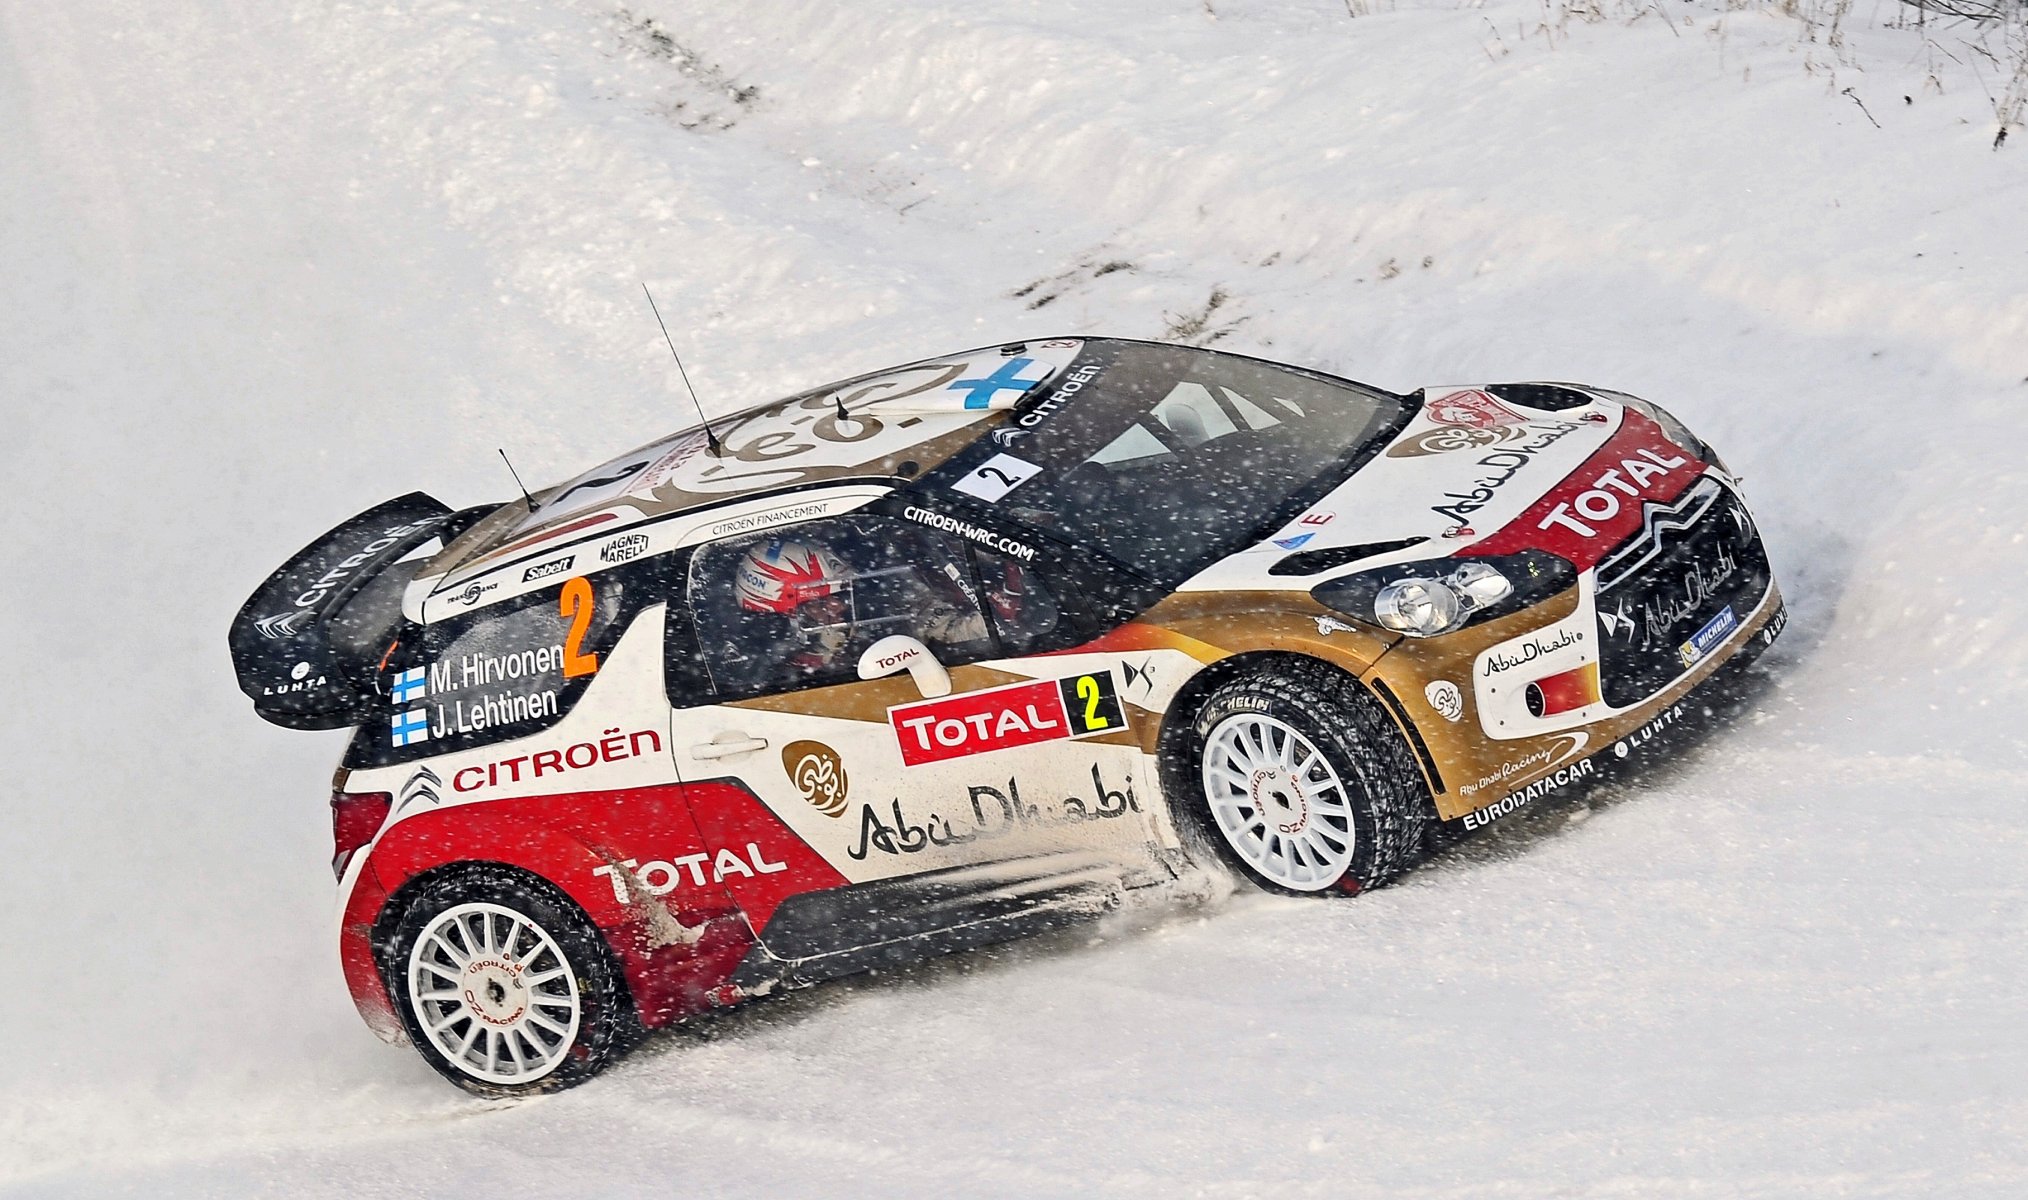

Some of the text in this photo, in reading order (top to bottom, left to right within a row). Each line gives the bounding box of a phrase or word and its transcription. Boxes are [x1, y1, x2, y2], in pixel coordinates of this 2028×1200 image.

[976, 466, 1022, 488] 2
[1537, 447, 1687, 539] TOTAL
[757, 503, 829, 525] FINANCEMENT
[903, 505, 1035, 562] CITROEN-WRC.COM
[1300, 513, 1334, 526] E
[526, 558, 571, 581] Sabelt
[559, 575, 598, 679] 2
[1697, 611, 1733, 648] MICHELIN
[430, 644, 565, 695] M. Hirvonen
[875, 647, 920, 670] TOTAL
[263, 675, 327, 696] LUHTA
[1077, 675, 1109, 730] 2
[432, 689, 558, 739] J. Lehtinen
[902, 704, 1058, 751] TOTAL
[1629, 706, 1683, 748] LUHTA
[1459, 744, 1558, 796] Abu Dhabi Racing
[1462, 757, 1595, 831] EURODATACAR
[593, 842, 788, 904] TOTAL
[482, 1006, 524, 1025] RACING
